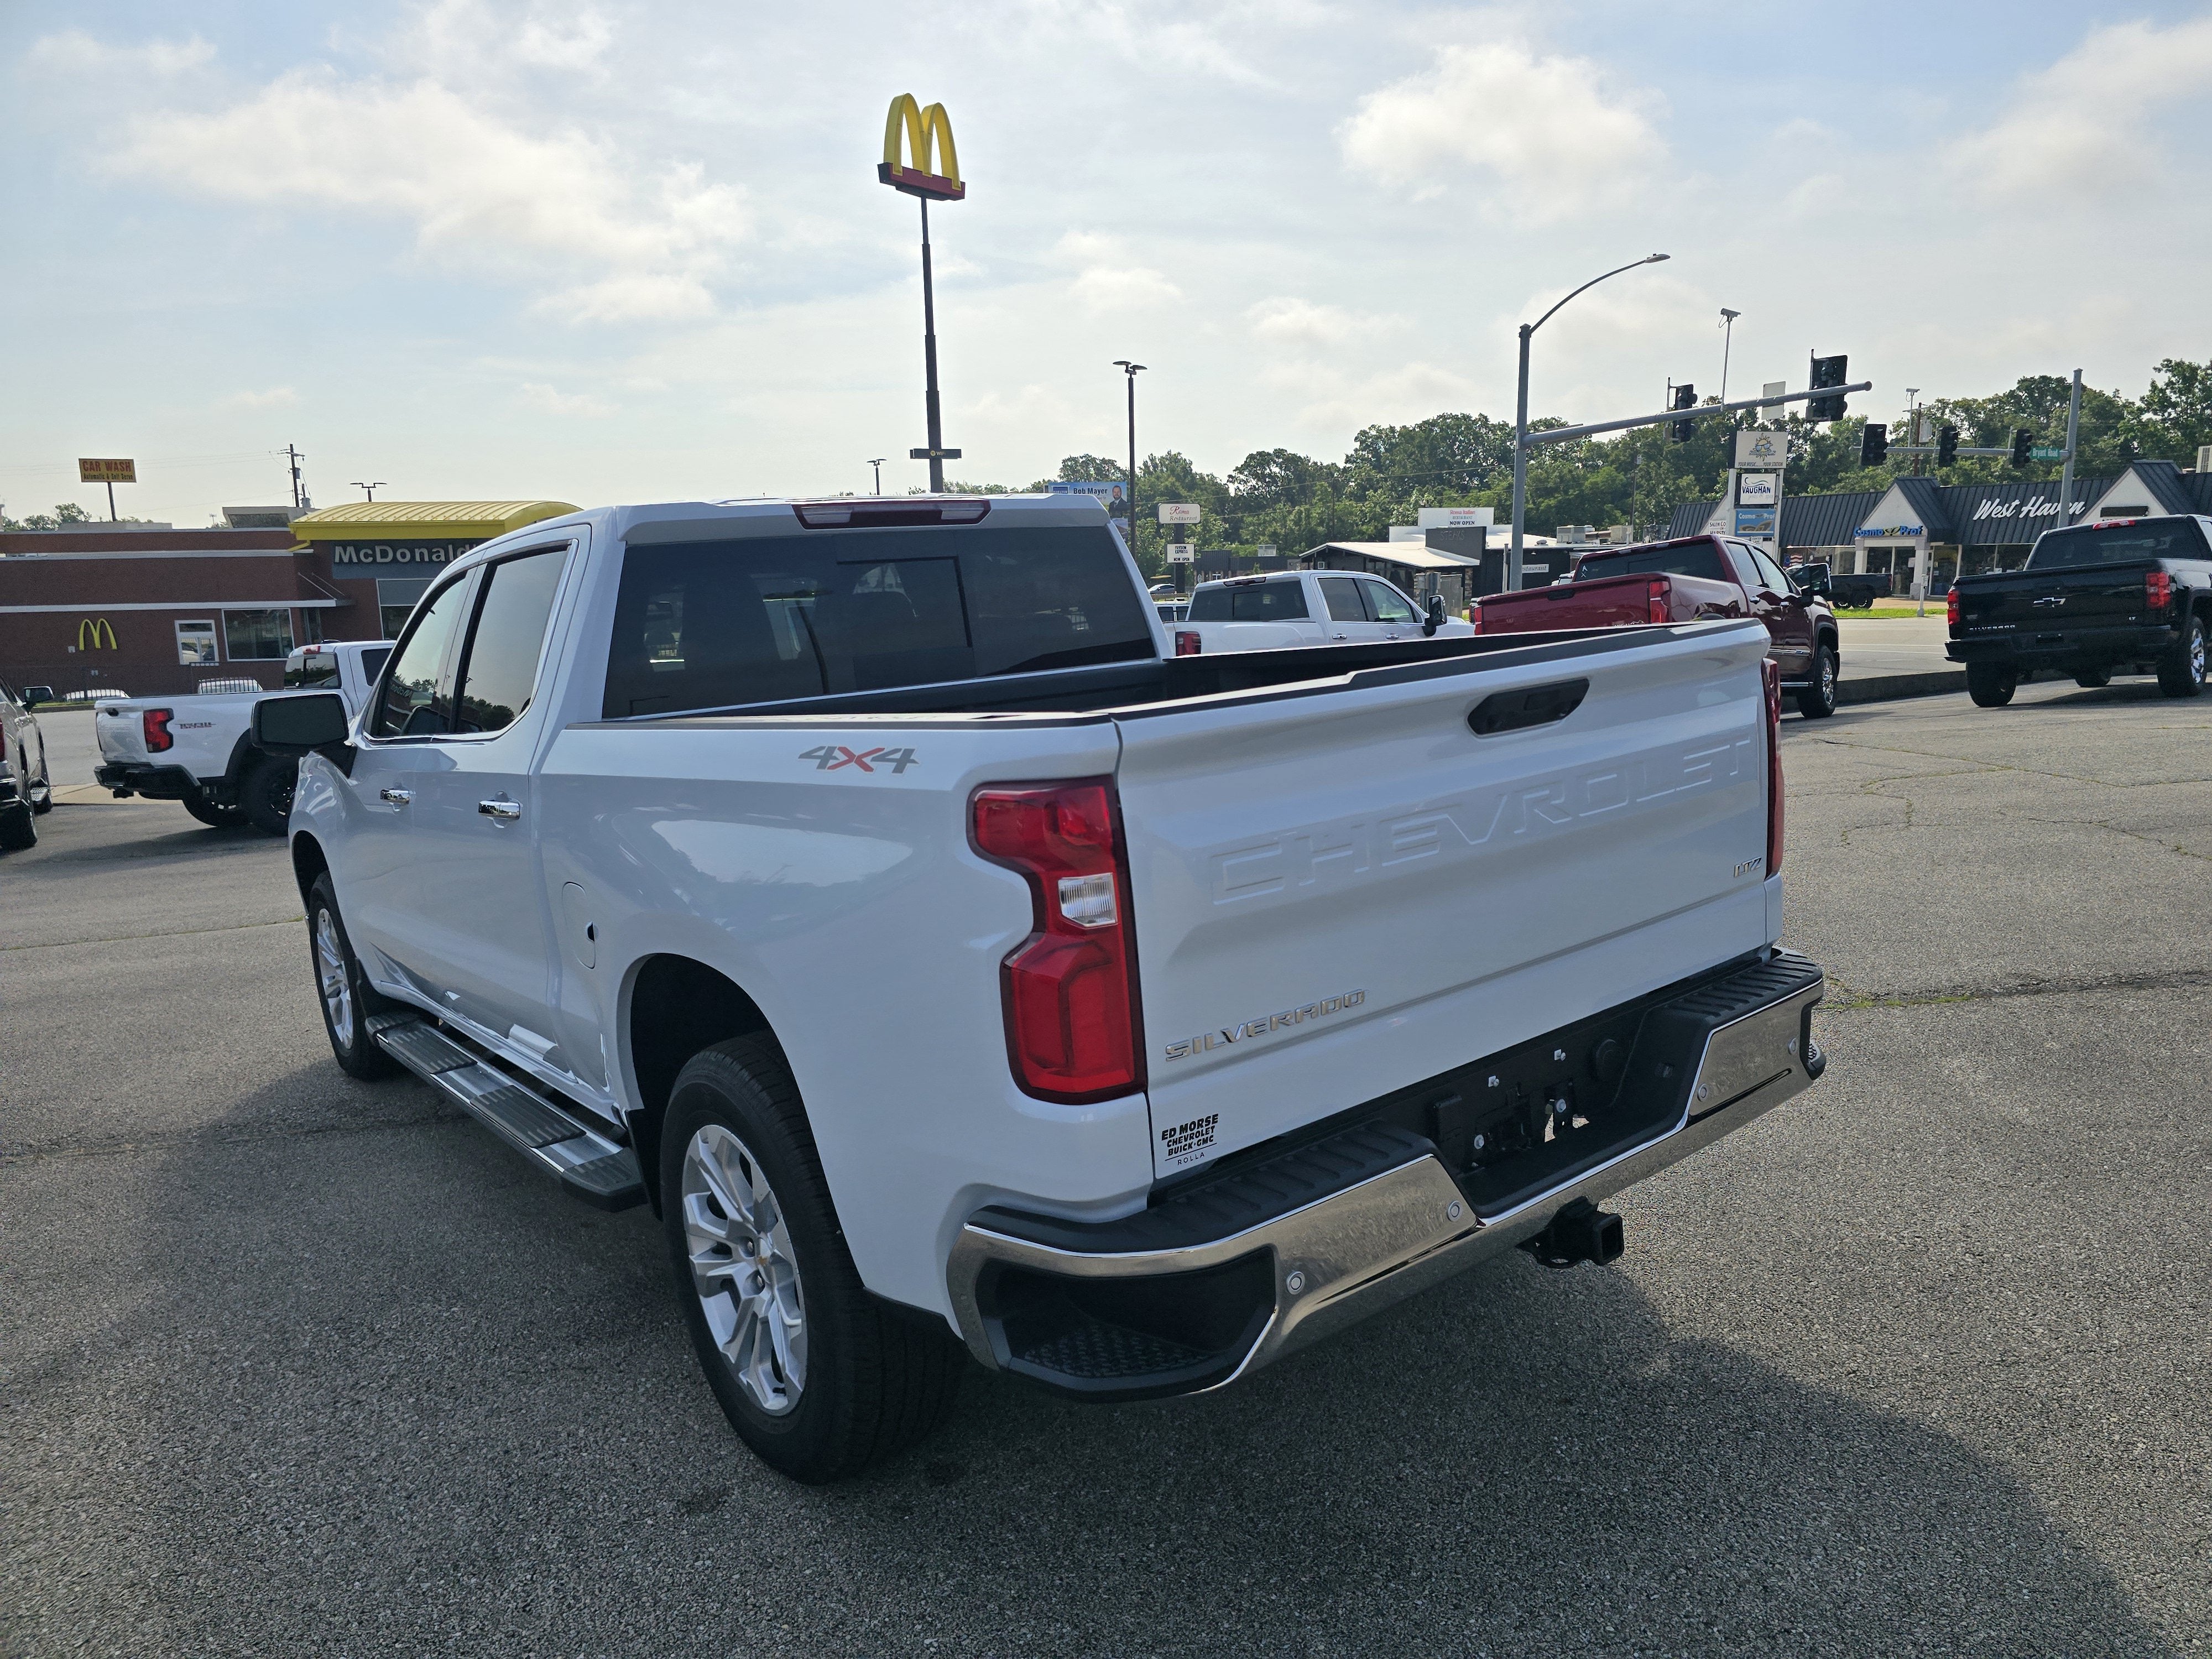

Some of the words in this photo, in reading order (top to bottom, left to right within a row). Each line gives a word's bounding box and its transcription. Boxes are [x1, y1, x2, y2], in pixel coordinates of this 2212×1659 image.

[83, 461, 101, 471] CAR
[105, 461, 132, 472] WASH
[1087, 487, 1108, 496] Mayer
[1742, 486, 1771, 494] VAUGHAN
[1170, 506, 1190, 515] Roma
[1973, 498, 2020, 520] West
[2019, 495, 2085, 518] Havn
[1854, 526, 1885, 536] Cosmo
[1900, 525, 1923, 535] Prof
[1211, 739, 1752, 906] CHEVROLET
[1734, 857, 1762, 878] LTZ
[1166, 989, 1366, 1061] SILVERADO
[1162, 1128, 1176, 1141] ED
[1179, 1113, 1219, 1135] MORSE
[1167, 1125, 1215, 1147] CHEVROLET
[1177, 1152, 1204, 1166] ROLLA
